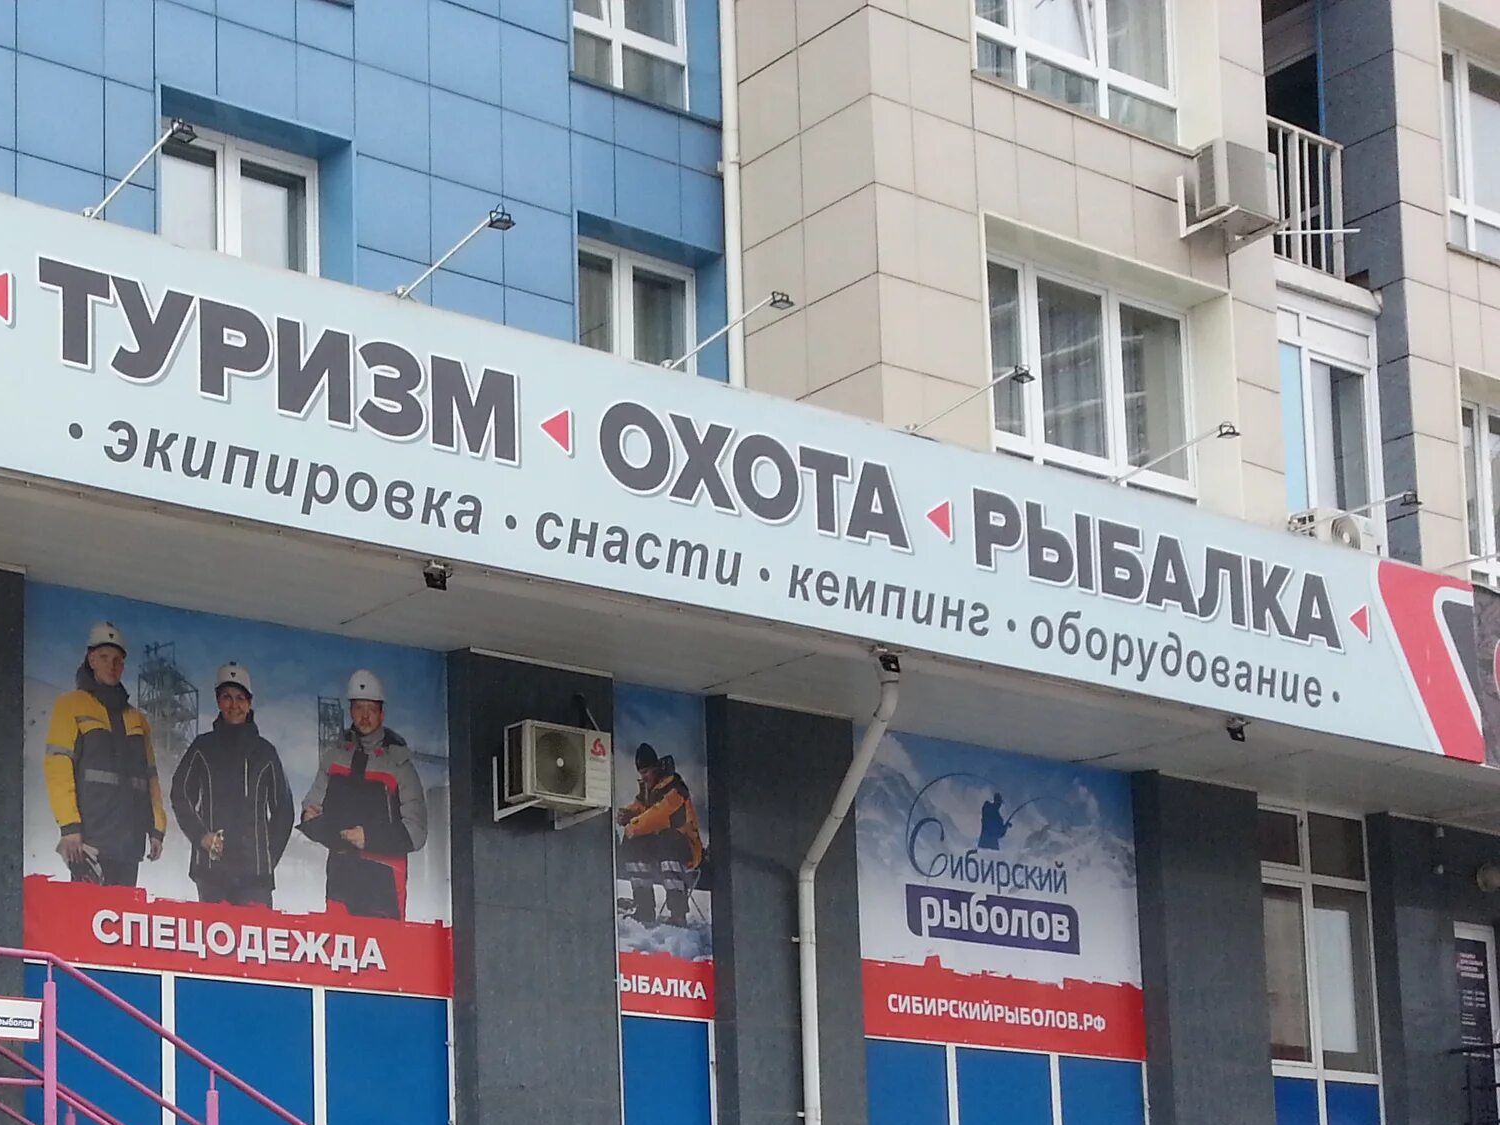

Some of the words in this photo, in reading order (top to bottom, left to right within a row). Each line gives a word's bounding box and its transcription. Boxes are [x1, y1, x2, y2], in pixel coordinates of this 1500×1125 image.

[36, 254, 520, 466] ТУРИЗМ
[598, 400, 911, 553] ОХОТА
[972, 486, 1345, 654] РЫБАЛКА
[104, 418, 483, 536] экипировка
[534, 509, 742, 588] снасти
[788, 563, 991, 640] кемпинг
[1030, 611, 1325, 710] оборудование
[905, 792, 1068, 895] Сибирский
[91, 909, 387, 973] СПЕЦОДЕЖДА
[920, 893, 1072, 944] рыболов
[887, 992, 1107, 1033] СИБИРСКИЙРЫБОЛОВ.РФ
